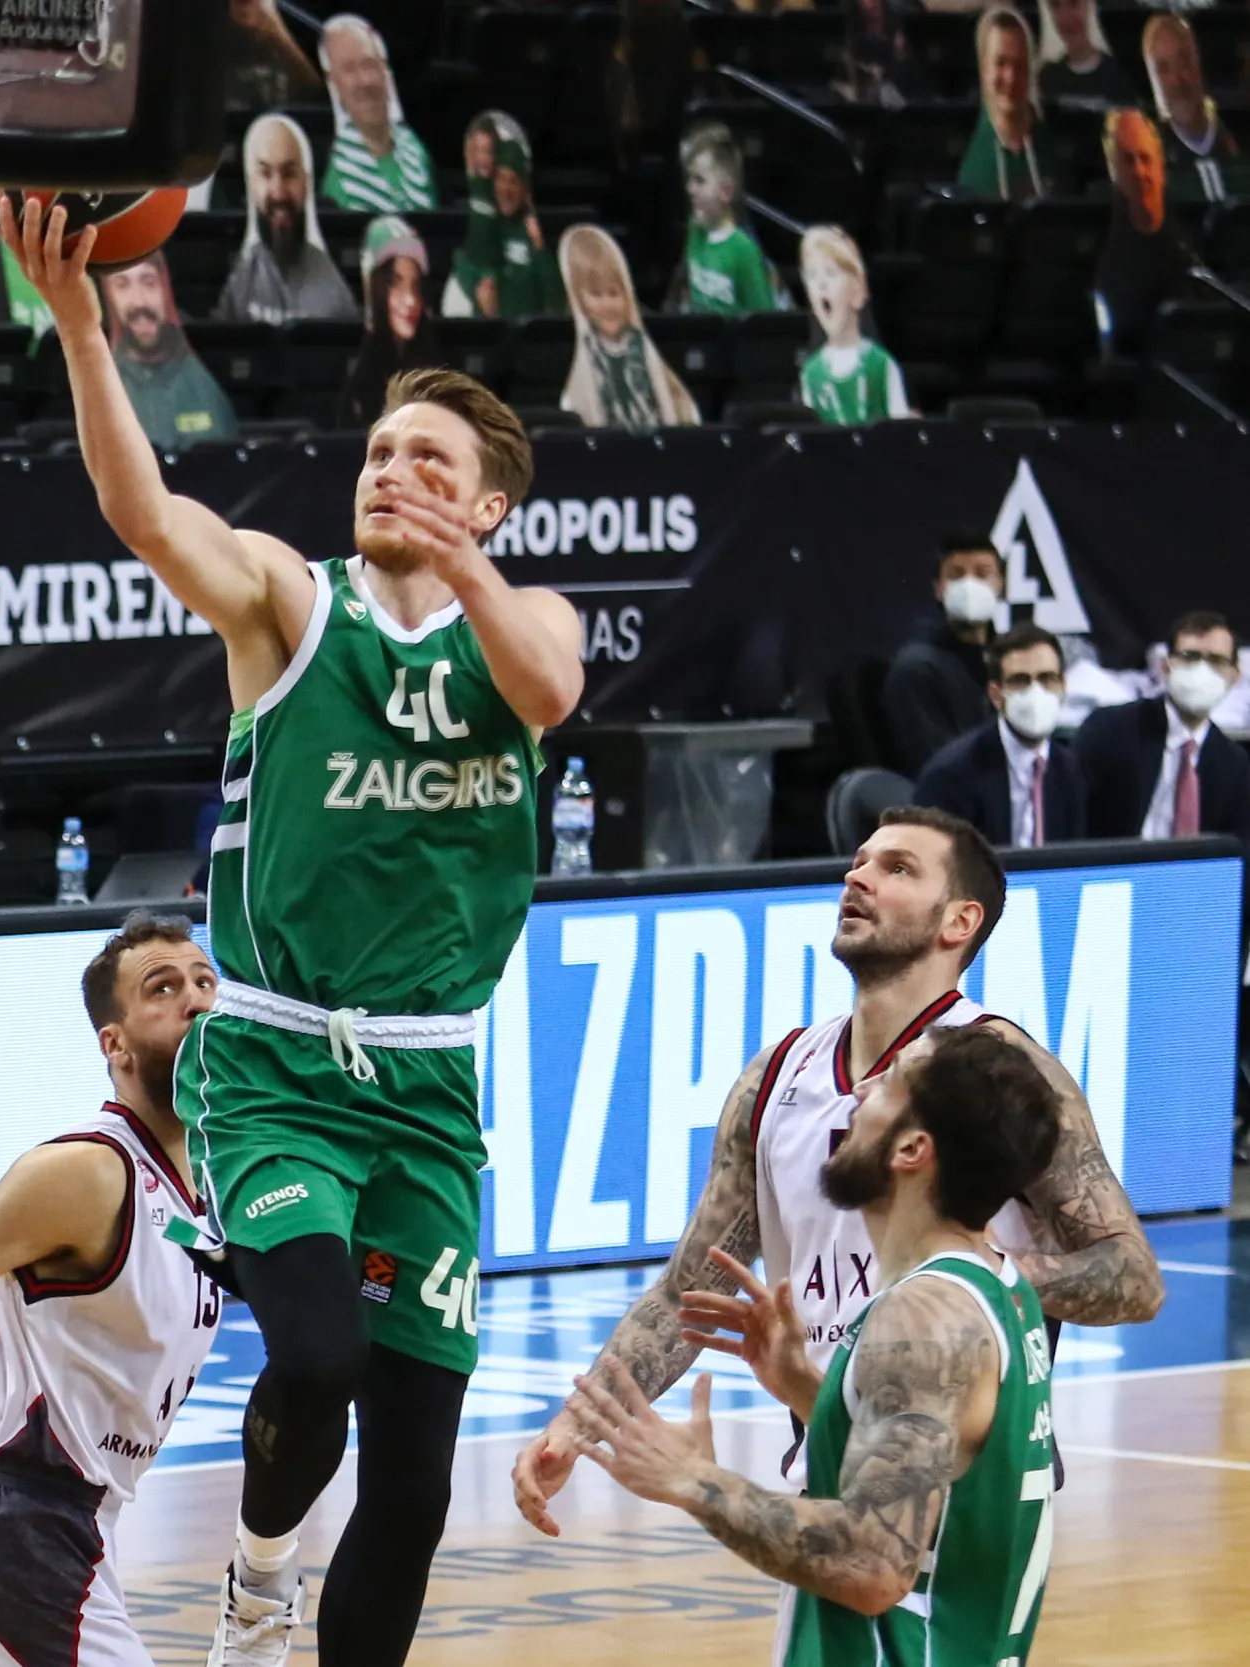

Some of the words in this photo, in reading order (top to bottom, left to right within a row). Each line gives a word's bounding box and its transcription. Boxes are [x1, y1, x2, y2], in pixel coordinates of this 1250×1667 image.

[481, 494, 699, 558] ROPOLIS
[323, 752, 524, 812] ŽALGIRIS
[245, 1183, 310, 1219] UTENOS
